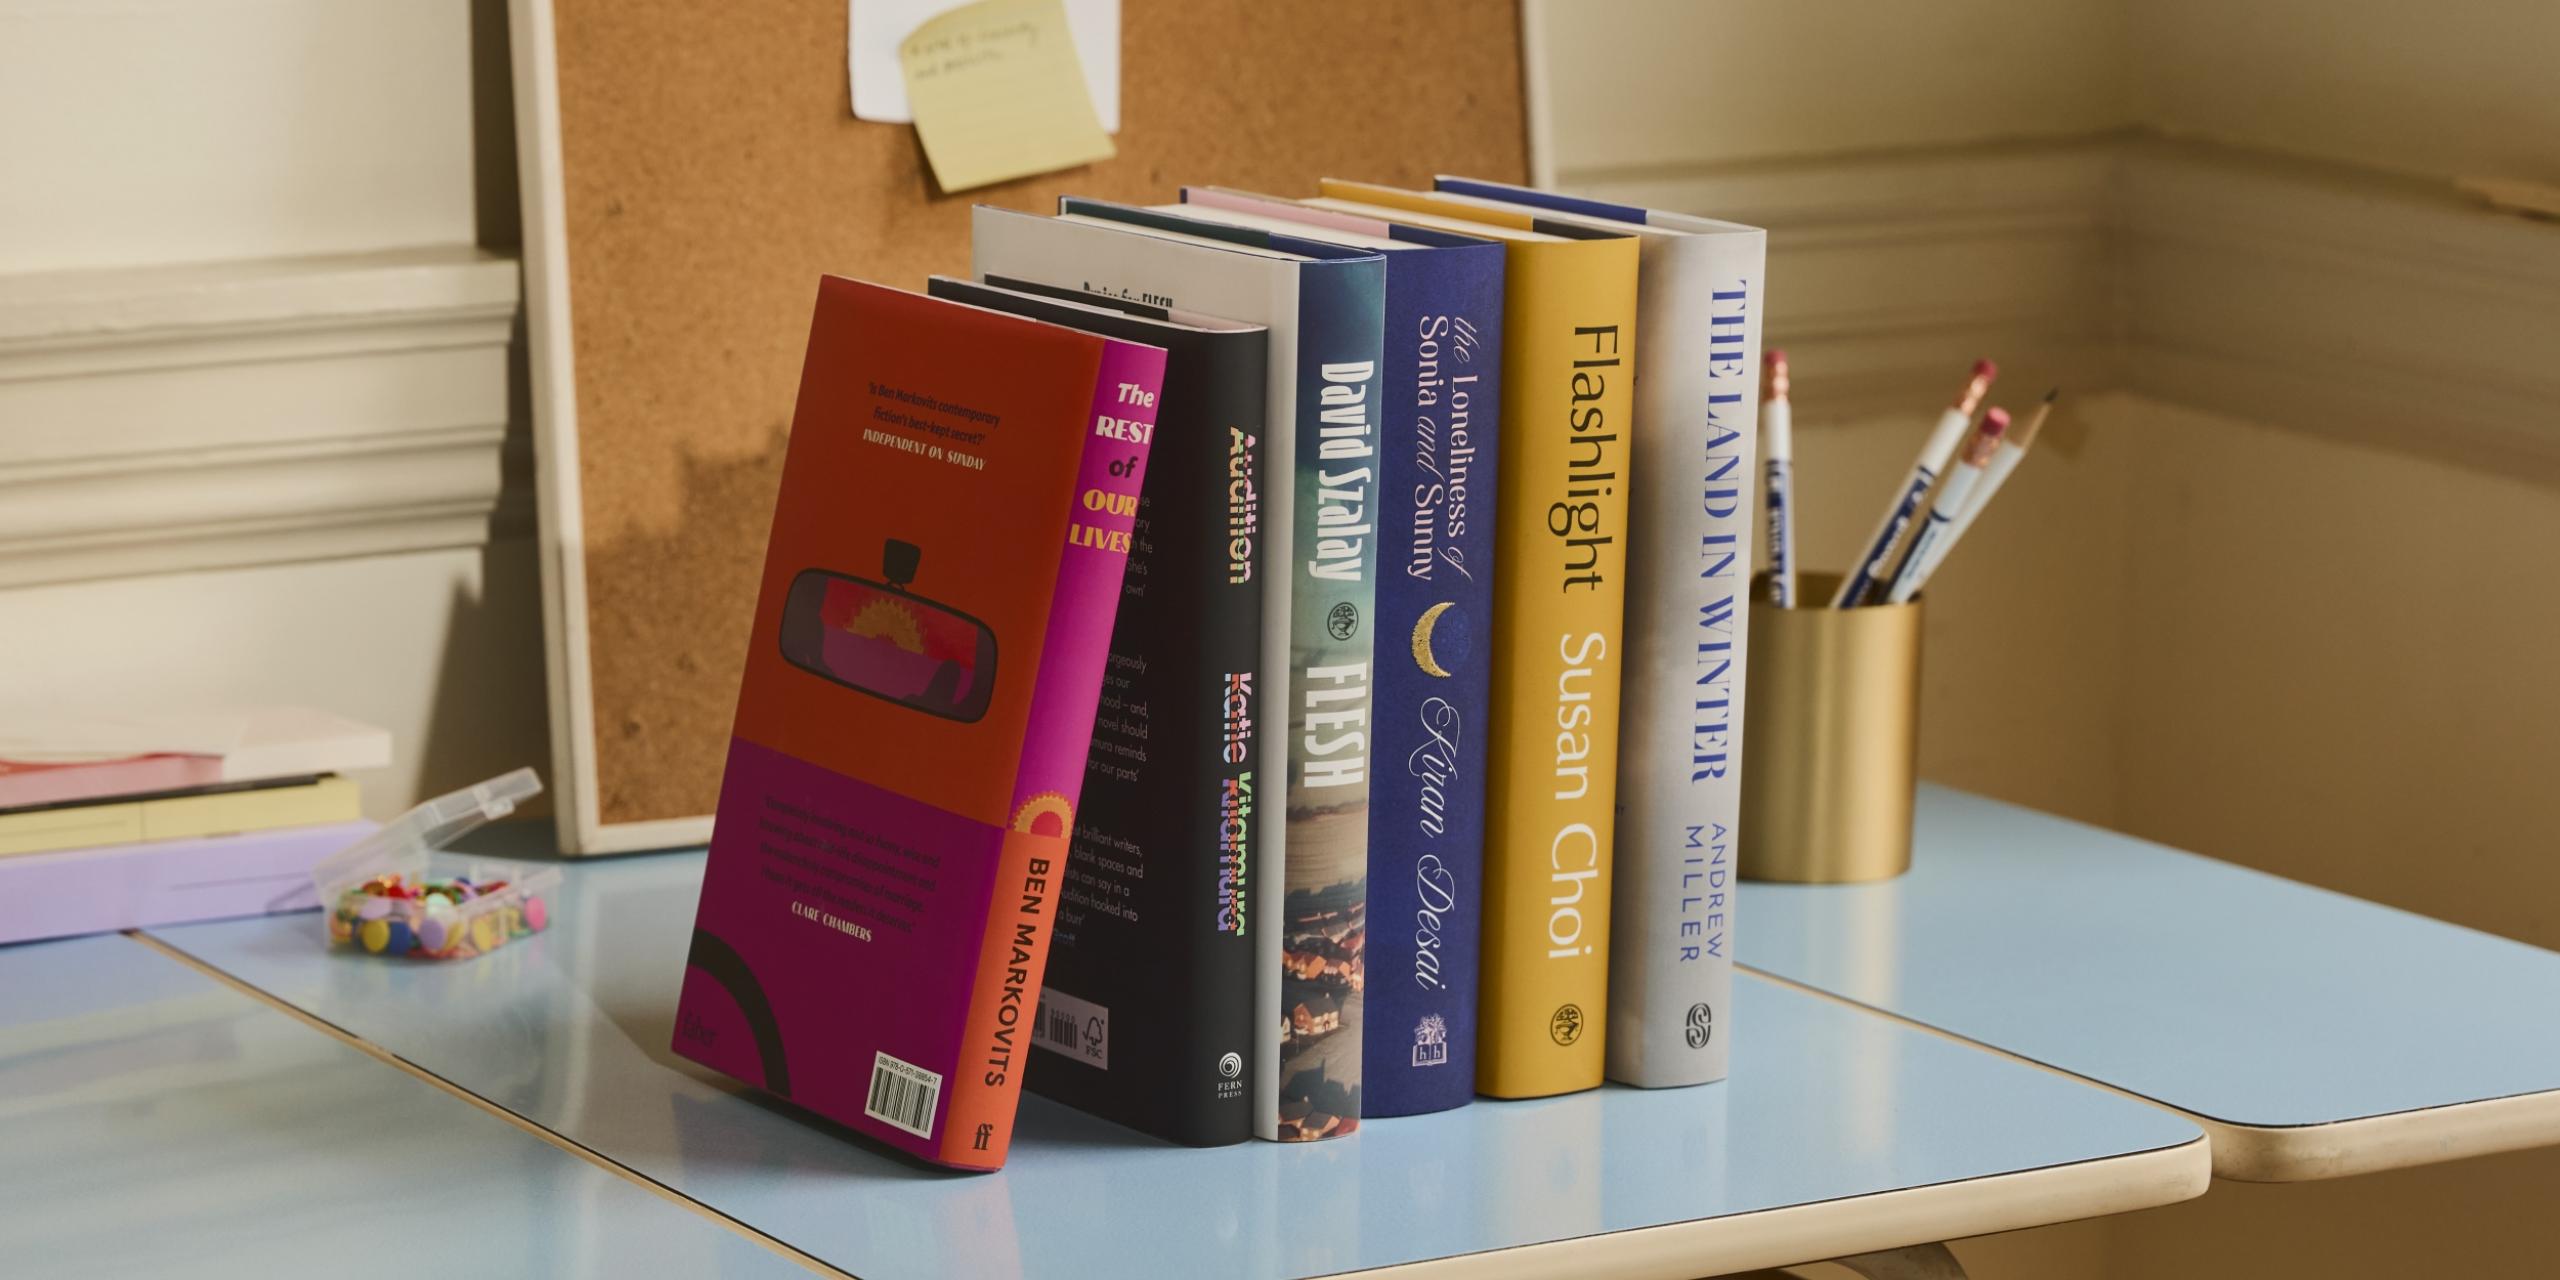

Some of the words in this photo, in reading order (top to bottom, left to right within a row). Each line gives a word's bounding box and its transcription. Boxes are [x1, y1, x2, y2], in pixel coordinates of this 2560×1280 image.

[1417, 315, 1449, 407] Sonia
[1453, 316, 1480, 364] the
[1709, 280, 1746, 378] THE
[879, 384, 895, 398] Ben
[895, 388, 937, 410] Markovits
[938, 402, 1000, 429] contemporary
[1117, 382, 1155, 408] The
[1319, 360, 1374, 459] David
[863, 428, 927, 455] INDEPENDENT
[928, 445, 944, 460] ON
[947, 450, 986, 471] SUNDAY
[1095, 415, 1154, 445] REST
[1416, 416, 1445, 482] and
[1448, 375, 1478, 538] Loneliness
[1548, 325, 1620, 593] Flashlight
[1704, 391, 1742, 518] LAND
[1109, 456, 1139, 479] of
[1083, 488, 1138, 517] OUR
[1229, 426, 1257, 584] Audition
[1308, 467, 1372, 581] Szalay
[1407, 483, 1444, 581] Sunny
[1068, 523, 1132, 554] LIVES
[1437, 546, 1473, 583] of
[1700, 532, 1736, 578] IN
[1223, 672, 1252, 763] Katie
[1555, 632, 1606, 800] Susan
[1692, 595, 1734, 786] WINTER
[1115, 745, 1147, 762] reminds
[1121, 719, 1148, 739] should
[1304, 662, 1367, 788] FLESH
[1408, 696, 1461, 839] Kiran
[1021, 857, 1050, 915] BEN
[1081, 872, 1096, 886] can
[1098, 879, 1112, 895] say
[1114, 880, 1121, 893] in
[1123, 886, 1130, 897] a
[1098, 856, 1125, 874] spaces
[1127, 863, 1144, 879] and
[1217, 772, 1252, 936] Kitamura
[791, 900, 820, 922] CLARE
[823, 913, 873, 943] CHAMBERS
[1091, 893, 1121, 916] hooked
[1122, 904, 1139, 921] into
[1414, 853, 1455, 991] Desai
[1548, 823, 1599, 959] Choi
[1680, 825, 1705, 962] MILLER
[1707, 823, 1727, 958] ANDREW
[984, 923, 1037, 1088] MARKOVITS
[1086, 1045, 1104, 1060] FSC
[1218, 1080, 1243, 1092] FERN
[1218, 1090, 1242, 1099] PRESS
